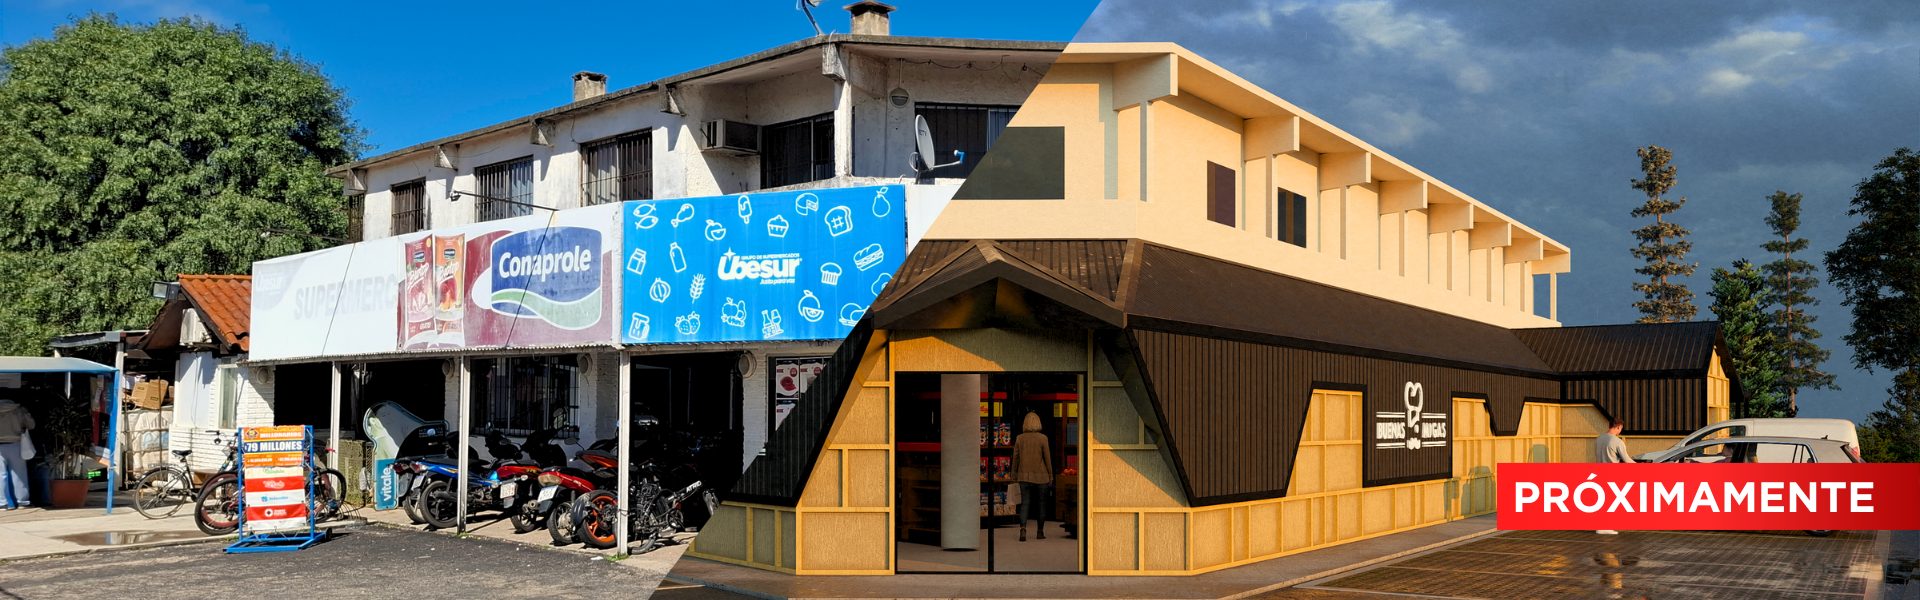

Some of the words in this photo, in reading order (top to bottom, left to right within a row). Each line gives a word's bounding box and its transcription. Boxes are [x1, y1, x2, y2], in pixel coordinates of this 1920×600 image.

[499, 245, 592, 282] Conaprole
[717, 254, 801, 281] Ubesur
[1376, 422, 1406, 439] BUENAS
[260, 441, 302, 451] MILLONES
[380, 466, 392, 501] vitale
